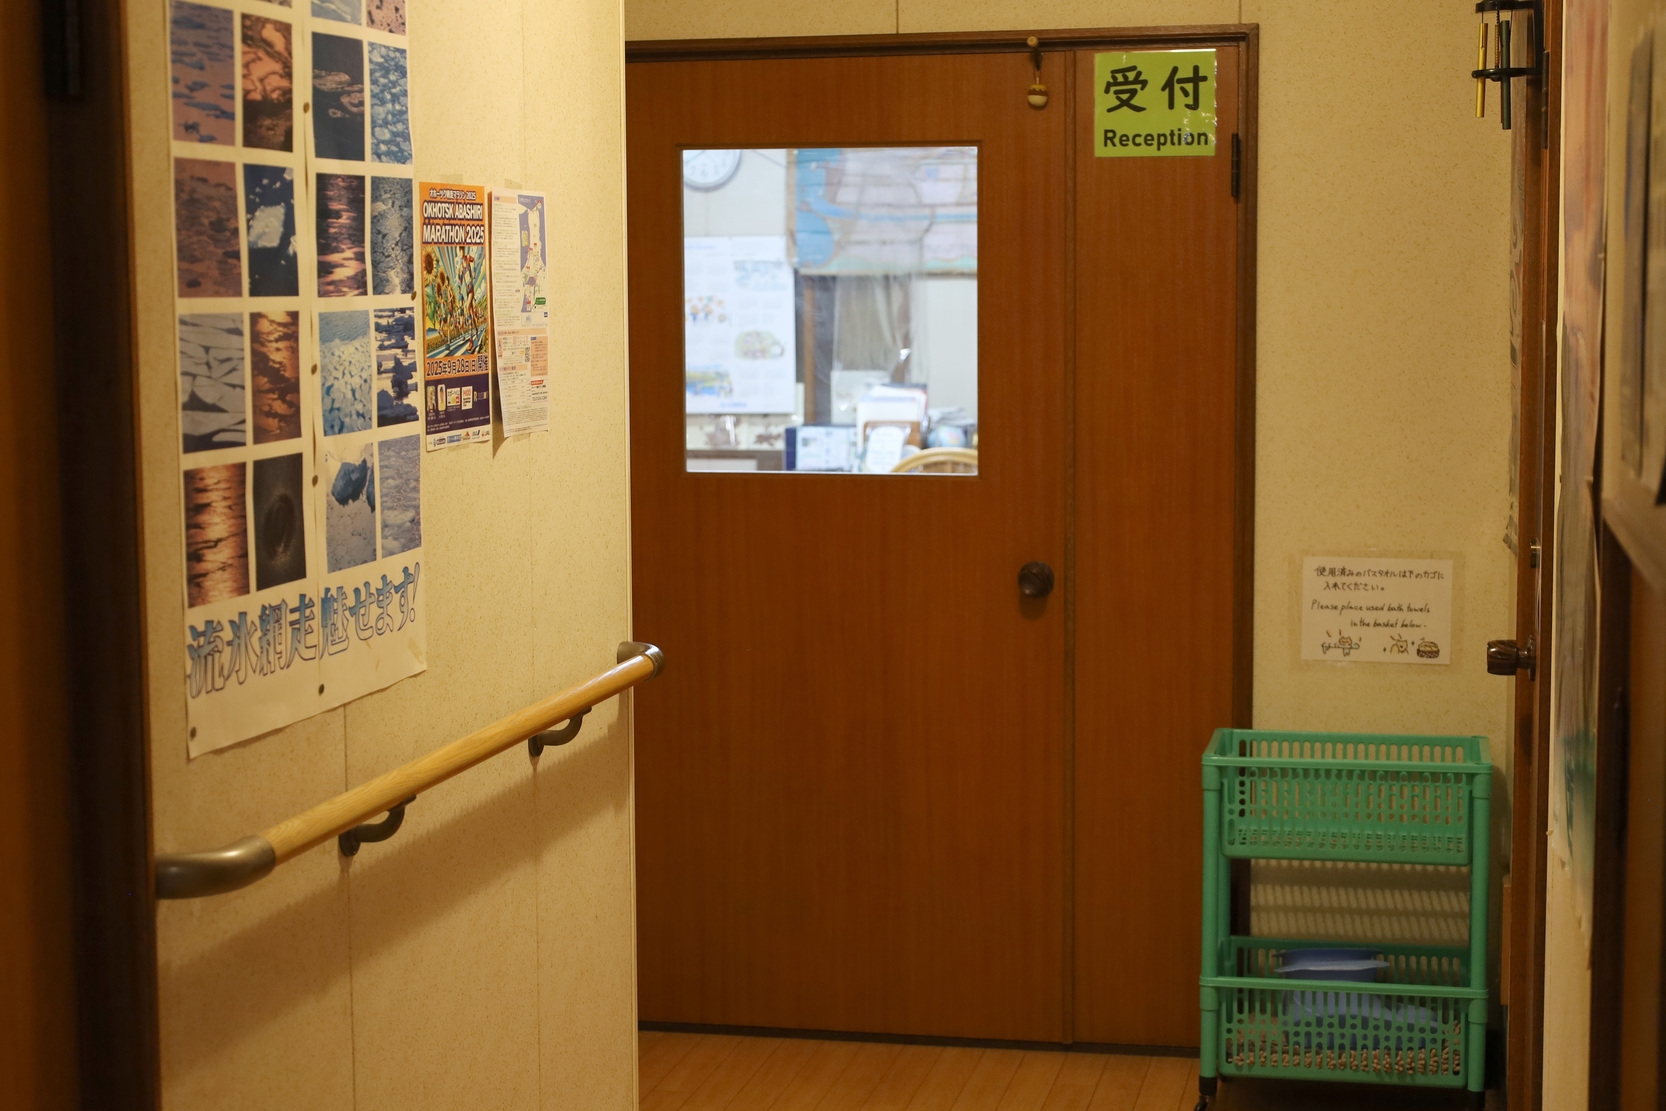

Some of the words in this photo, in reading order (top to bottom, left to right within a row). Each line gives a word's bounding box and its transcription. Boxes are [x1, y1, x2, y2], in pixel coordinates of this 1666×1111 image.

[1104, 65, 1208, 113] 受付
[1103, 128, 1208, 151] Reception
[423, 201, 454, 219] OKHOTSK
[454, 203, 483, 220] ABASHIRI
[422, 224, 465, 244] MARATHON
[465, 225, 485, 244] 2025
[1311, 598, 1338, 611] Please
[1339, 601, 1363, 615] place
[1366, 603, 1384, 612] used
[1387, 603, 1404, 612] bath
[1407, 603, 1431, 614] towels
[1359, 617, 1371, 628] the
[1373, 619, 1398, 629] basket
